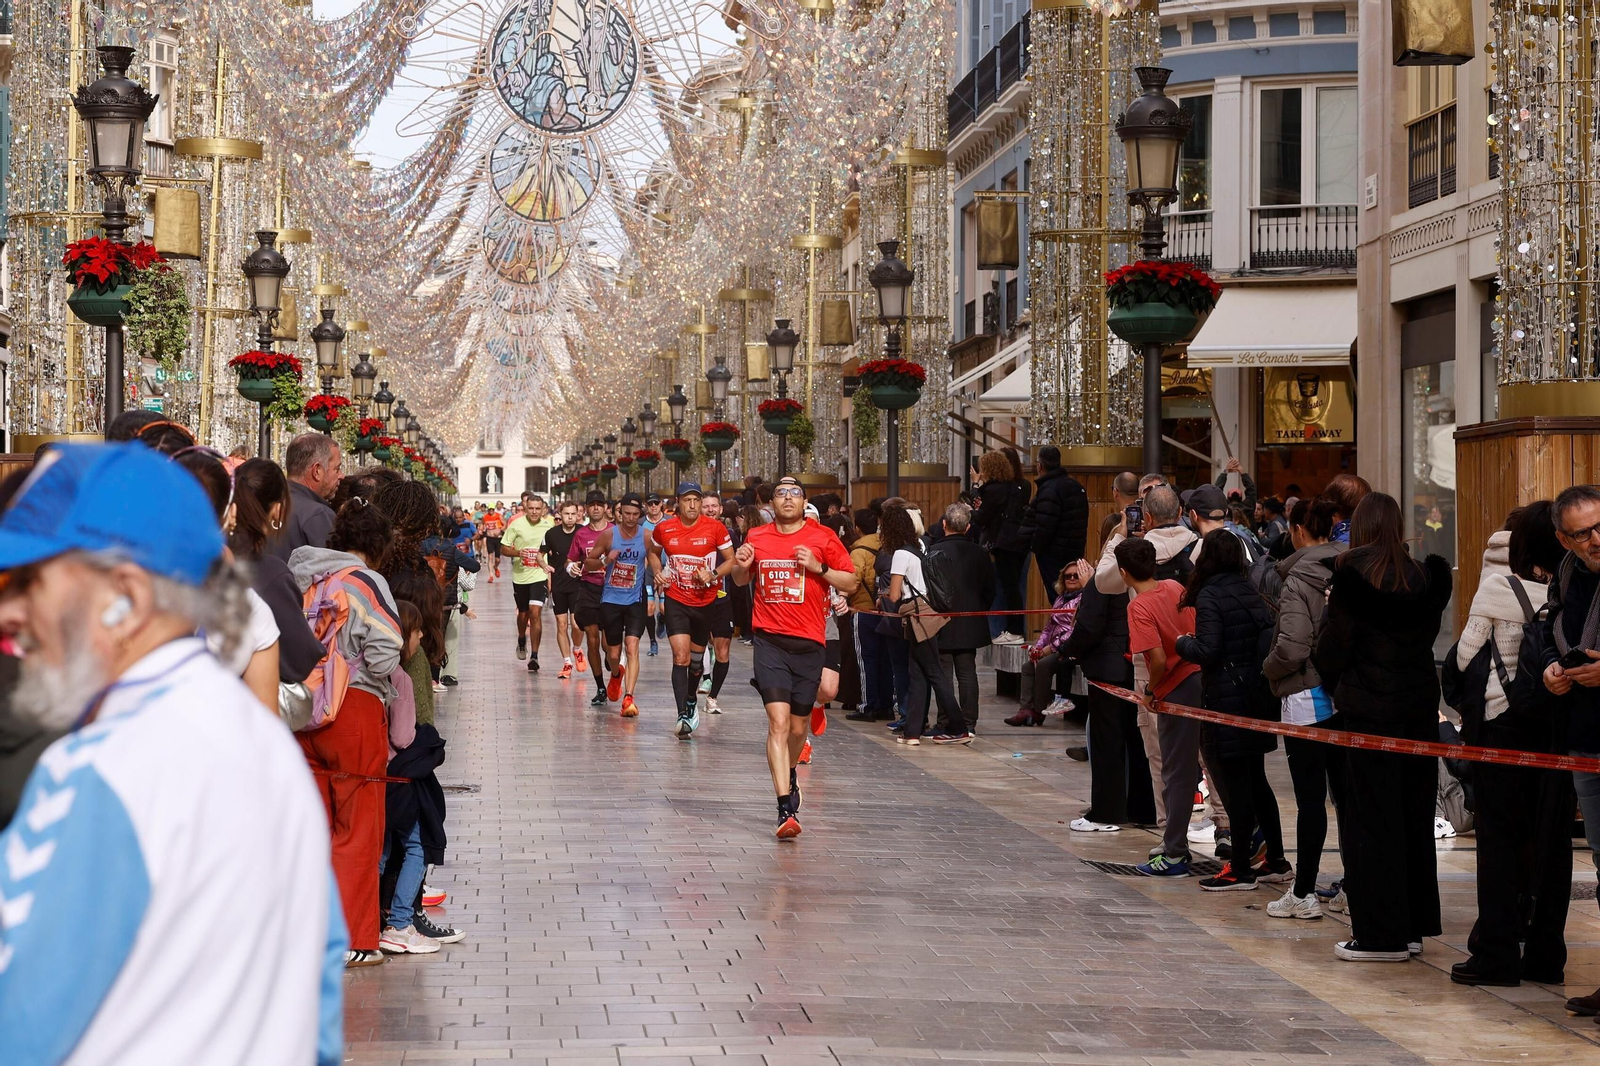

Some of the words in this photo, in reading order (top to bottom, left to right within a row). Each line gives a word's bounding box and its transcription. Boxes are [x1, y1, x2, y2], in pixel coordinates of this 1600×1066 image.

[1237, 351, 1255, 364] La
[1256, 351, 1300, 364] Canasta
[1275, 429, 1306, 439] TAKE
[1310, 429, 1343, 438] AWAY
[768, 570, 790, 579] 6103
